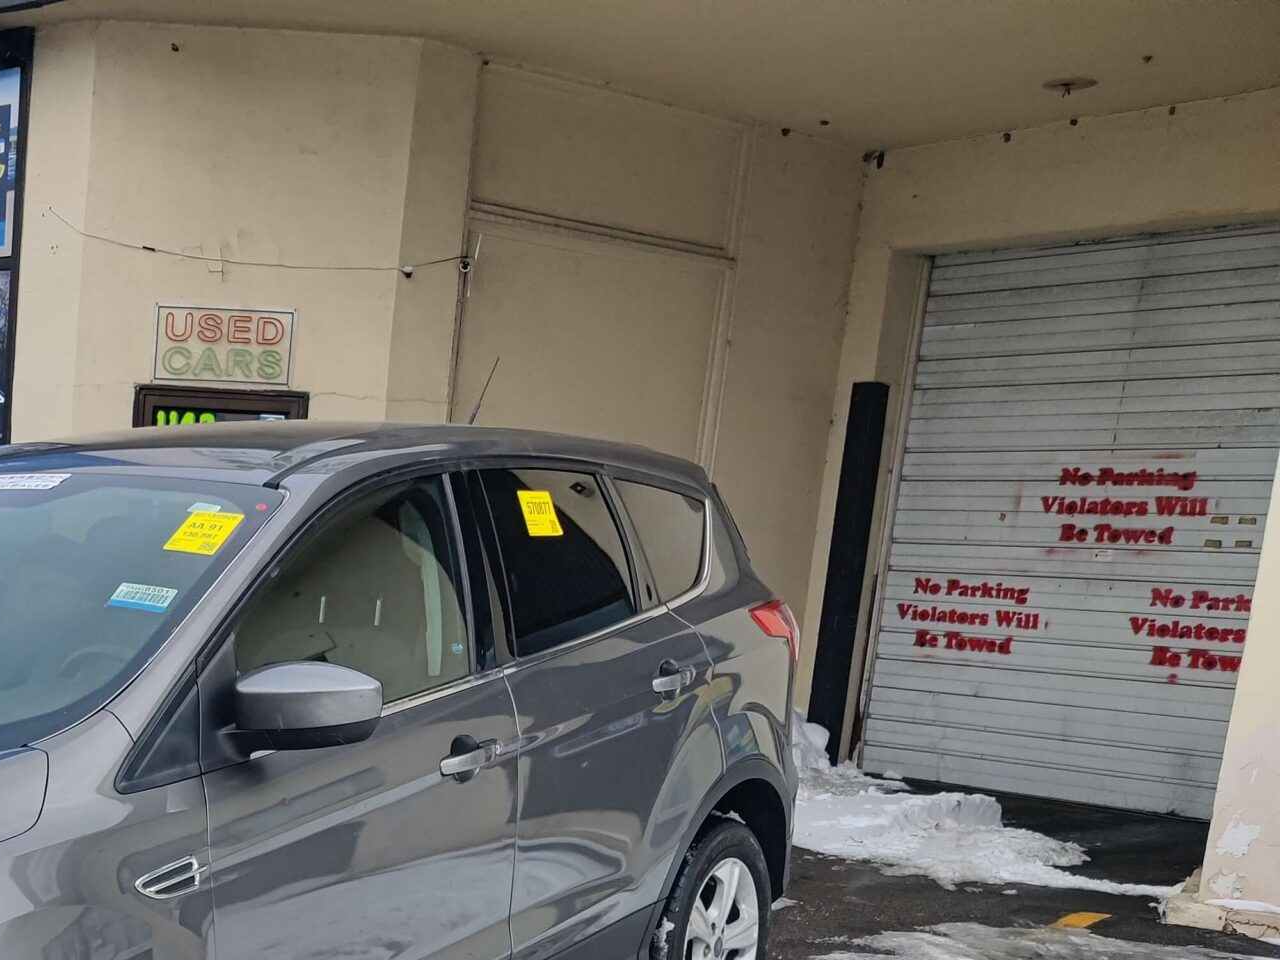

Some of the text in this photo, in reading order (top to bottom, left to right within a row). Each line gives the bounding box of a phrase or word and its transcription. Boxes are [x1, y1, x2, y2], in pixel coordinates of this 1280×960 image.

[165, 312, 285, 345] USED
[162, 346, 283, 380] CARS
[1059, 467, 1197, 491] No Parking
[1041, 496, 1208, 517] Violators Will
[1058, 523, 1175, 545] Be Towed
[913, 577, 1030, 605] No Parking
[1149, 587, 1252, 612] No Park
[896, 603, 1039, 630] Violators Will
[1128, 616, 1246, 643] Violators
[913, 629, 1014, 655] Be Towed
[1148, 646, 1242, 673] Be Tow
